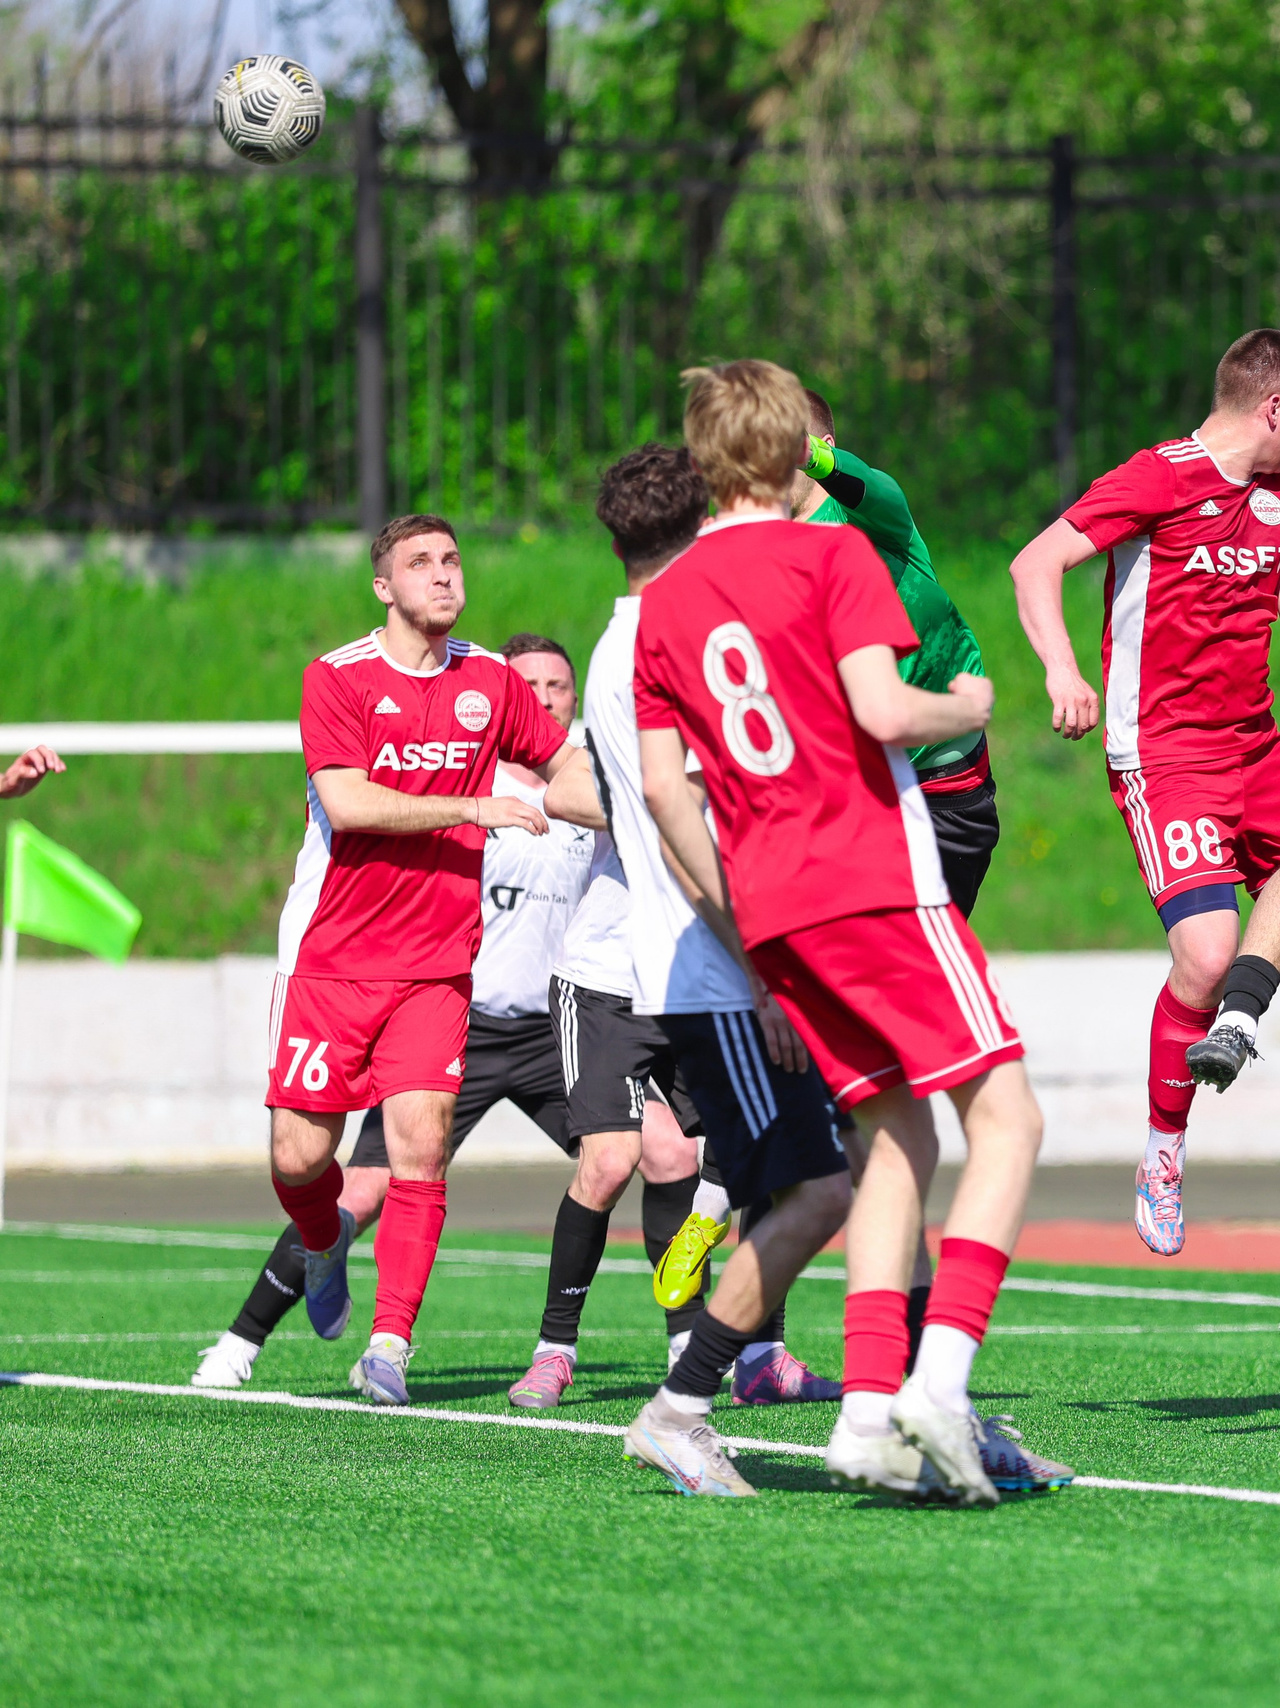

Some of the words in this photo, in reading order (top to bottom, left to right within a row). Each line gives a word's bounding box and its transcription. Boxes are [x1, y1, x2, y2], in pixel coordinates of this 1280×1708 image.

[375, 706, 402, 714] adidas
[702, 620, 796, 777] 8
[1163, 817, 1223, 870] 88
[283, 1036, 330, 1092] 76
